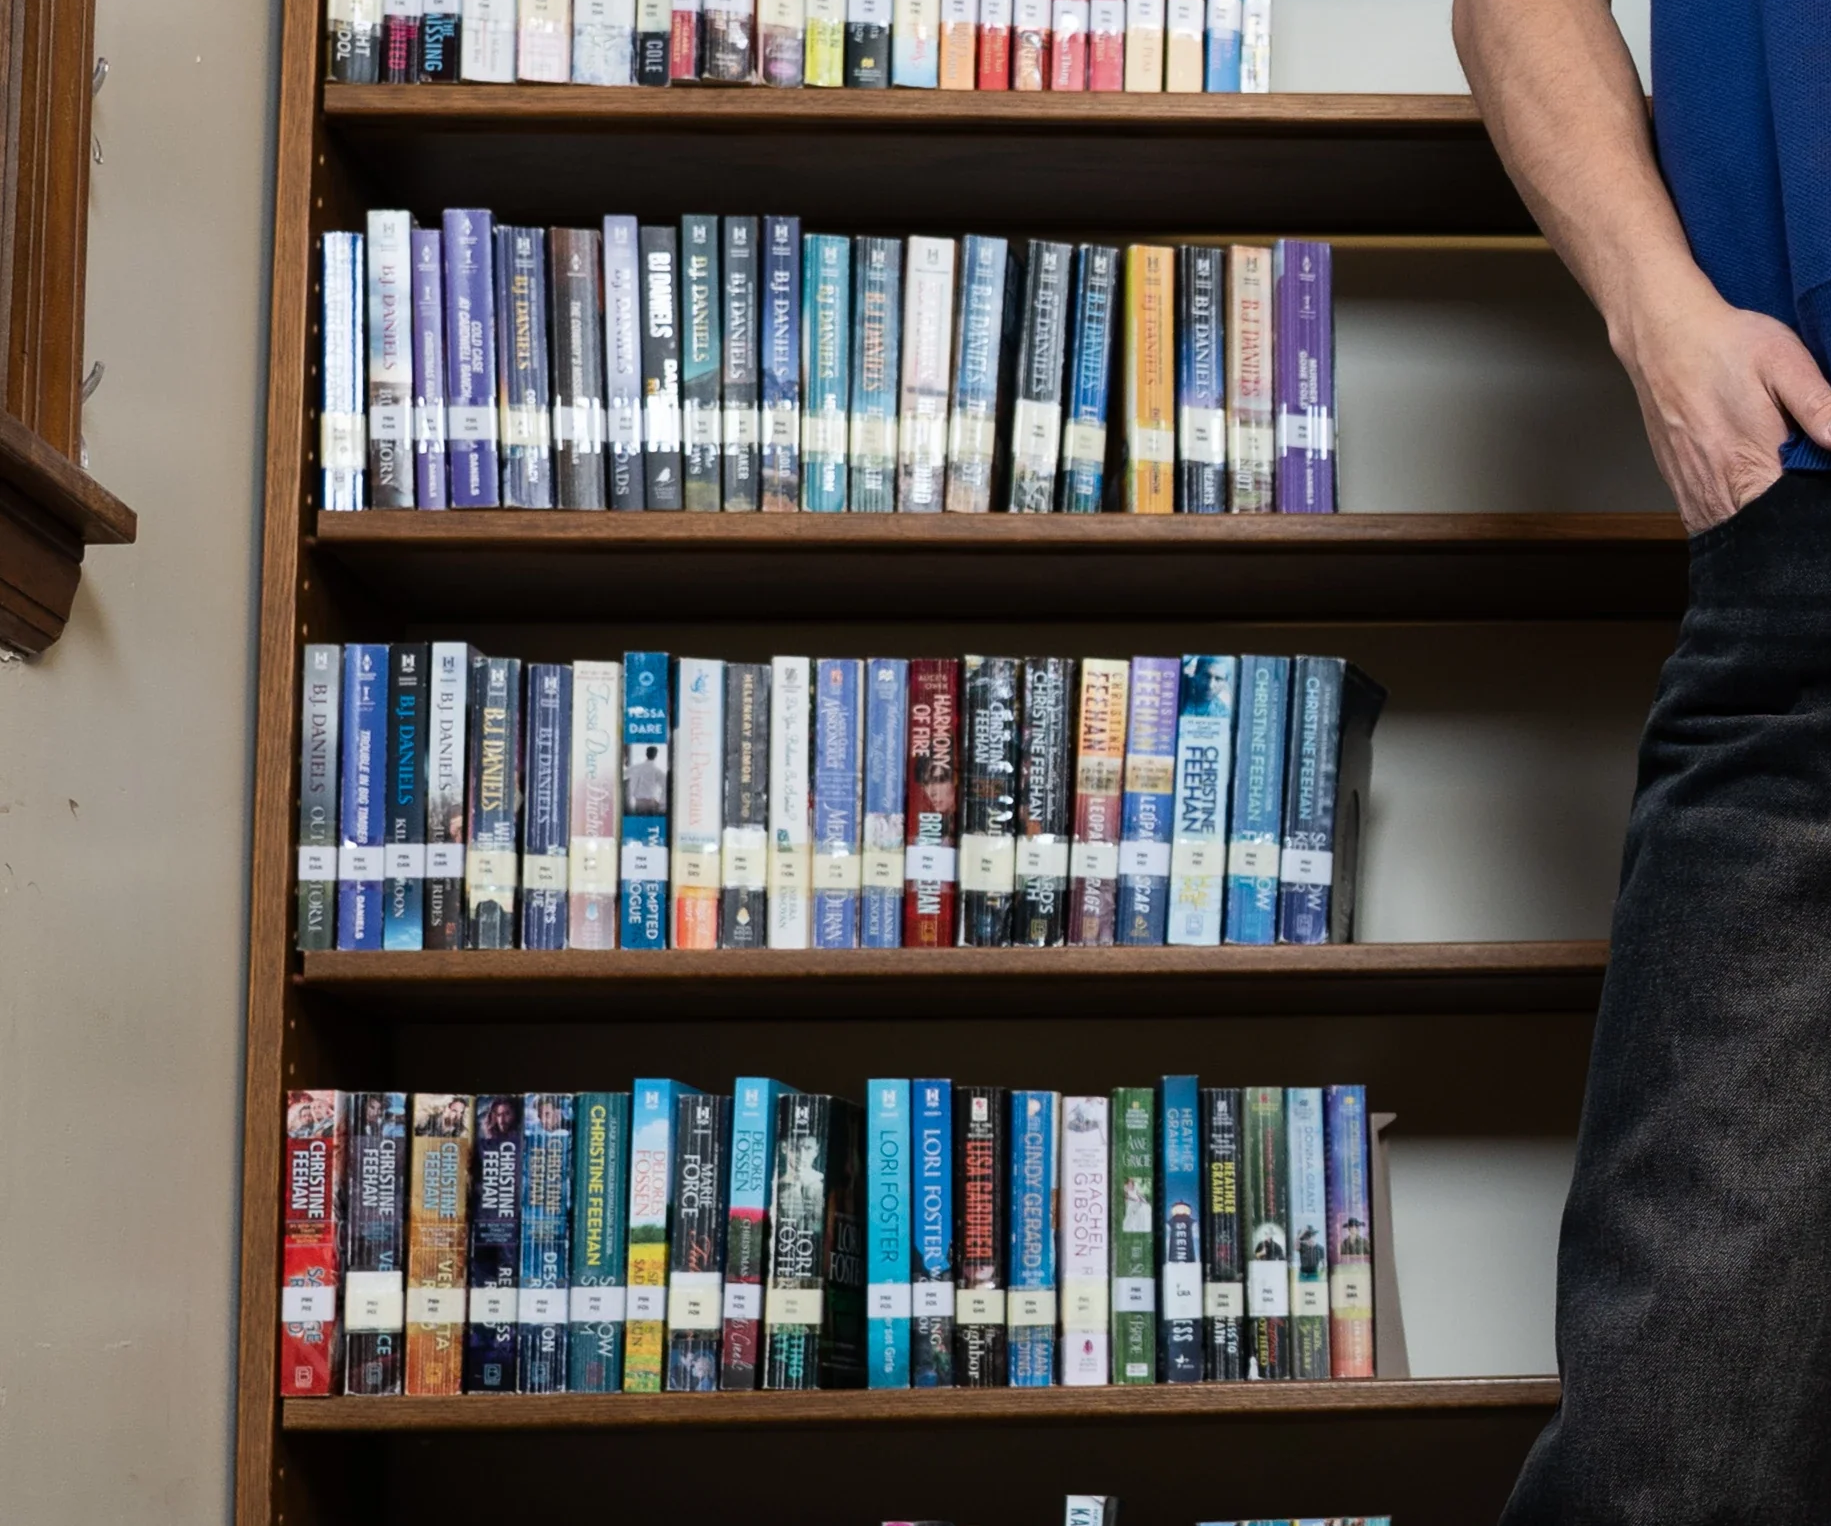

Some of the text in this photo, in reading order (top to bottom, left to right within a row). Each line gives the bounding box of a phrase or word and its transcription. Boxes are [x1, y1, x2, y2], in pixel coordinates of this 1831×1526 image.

[646, 41, 664, 73] COLE
[648, 274, 673, 337] DANIELS
[772, 299, 791, 377] DANIELS
[1298, 351, 1308, 409] GONE COLD
[1308, 358, 1318, 403] MURDER
[310, 684, 328, 792] B.J. DANIELS
[438, 691, 455, 791] B.J. DANIELS
[741, 673, 754, 783] HELENKAY DIMON
[912, 705, 929, 757] OF FIRE
[934, 695, 952, 770] HARMONY
[357, 730, 371, 843] TROUBLE IN BIG TIMBER
[1183, 746, 1201, 832] FEEHAN
[1200, 747, 1219, 834] CHRISTINE
[432, 884, 443, 926] RIDES
[292, 1151, 309, 1209] FEEHAN
[308, 1141, 326, 1218] CHRISTINE
[586, 1105, 606, 1265] CHRISTINE FEEHAN
[681, 1154, 700, 1218] FORCE
[698, 1163, 714, 1207] MARIE
[735, 1131, 752, 1191] FOSSEN
[750, 1131, 766, 1191] DELORES
[923, 1130, 942, 1261] LORI FOSTER
[966, 1140, 993, 1258] LISA GARDNER
[1211, 1162, 1224, 1214] GRAHAM
[1222, 1162, 1235, 1215] HEATHER
[1022, 1133, 1044, 1269] CINDY GERARD
[1074, 1173, 1090, 1257] GIBSON
[1090, 1173, 1103, 1255] RACHEL
